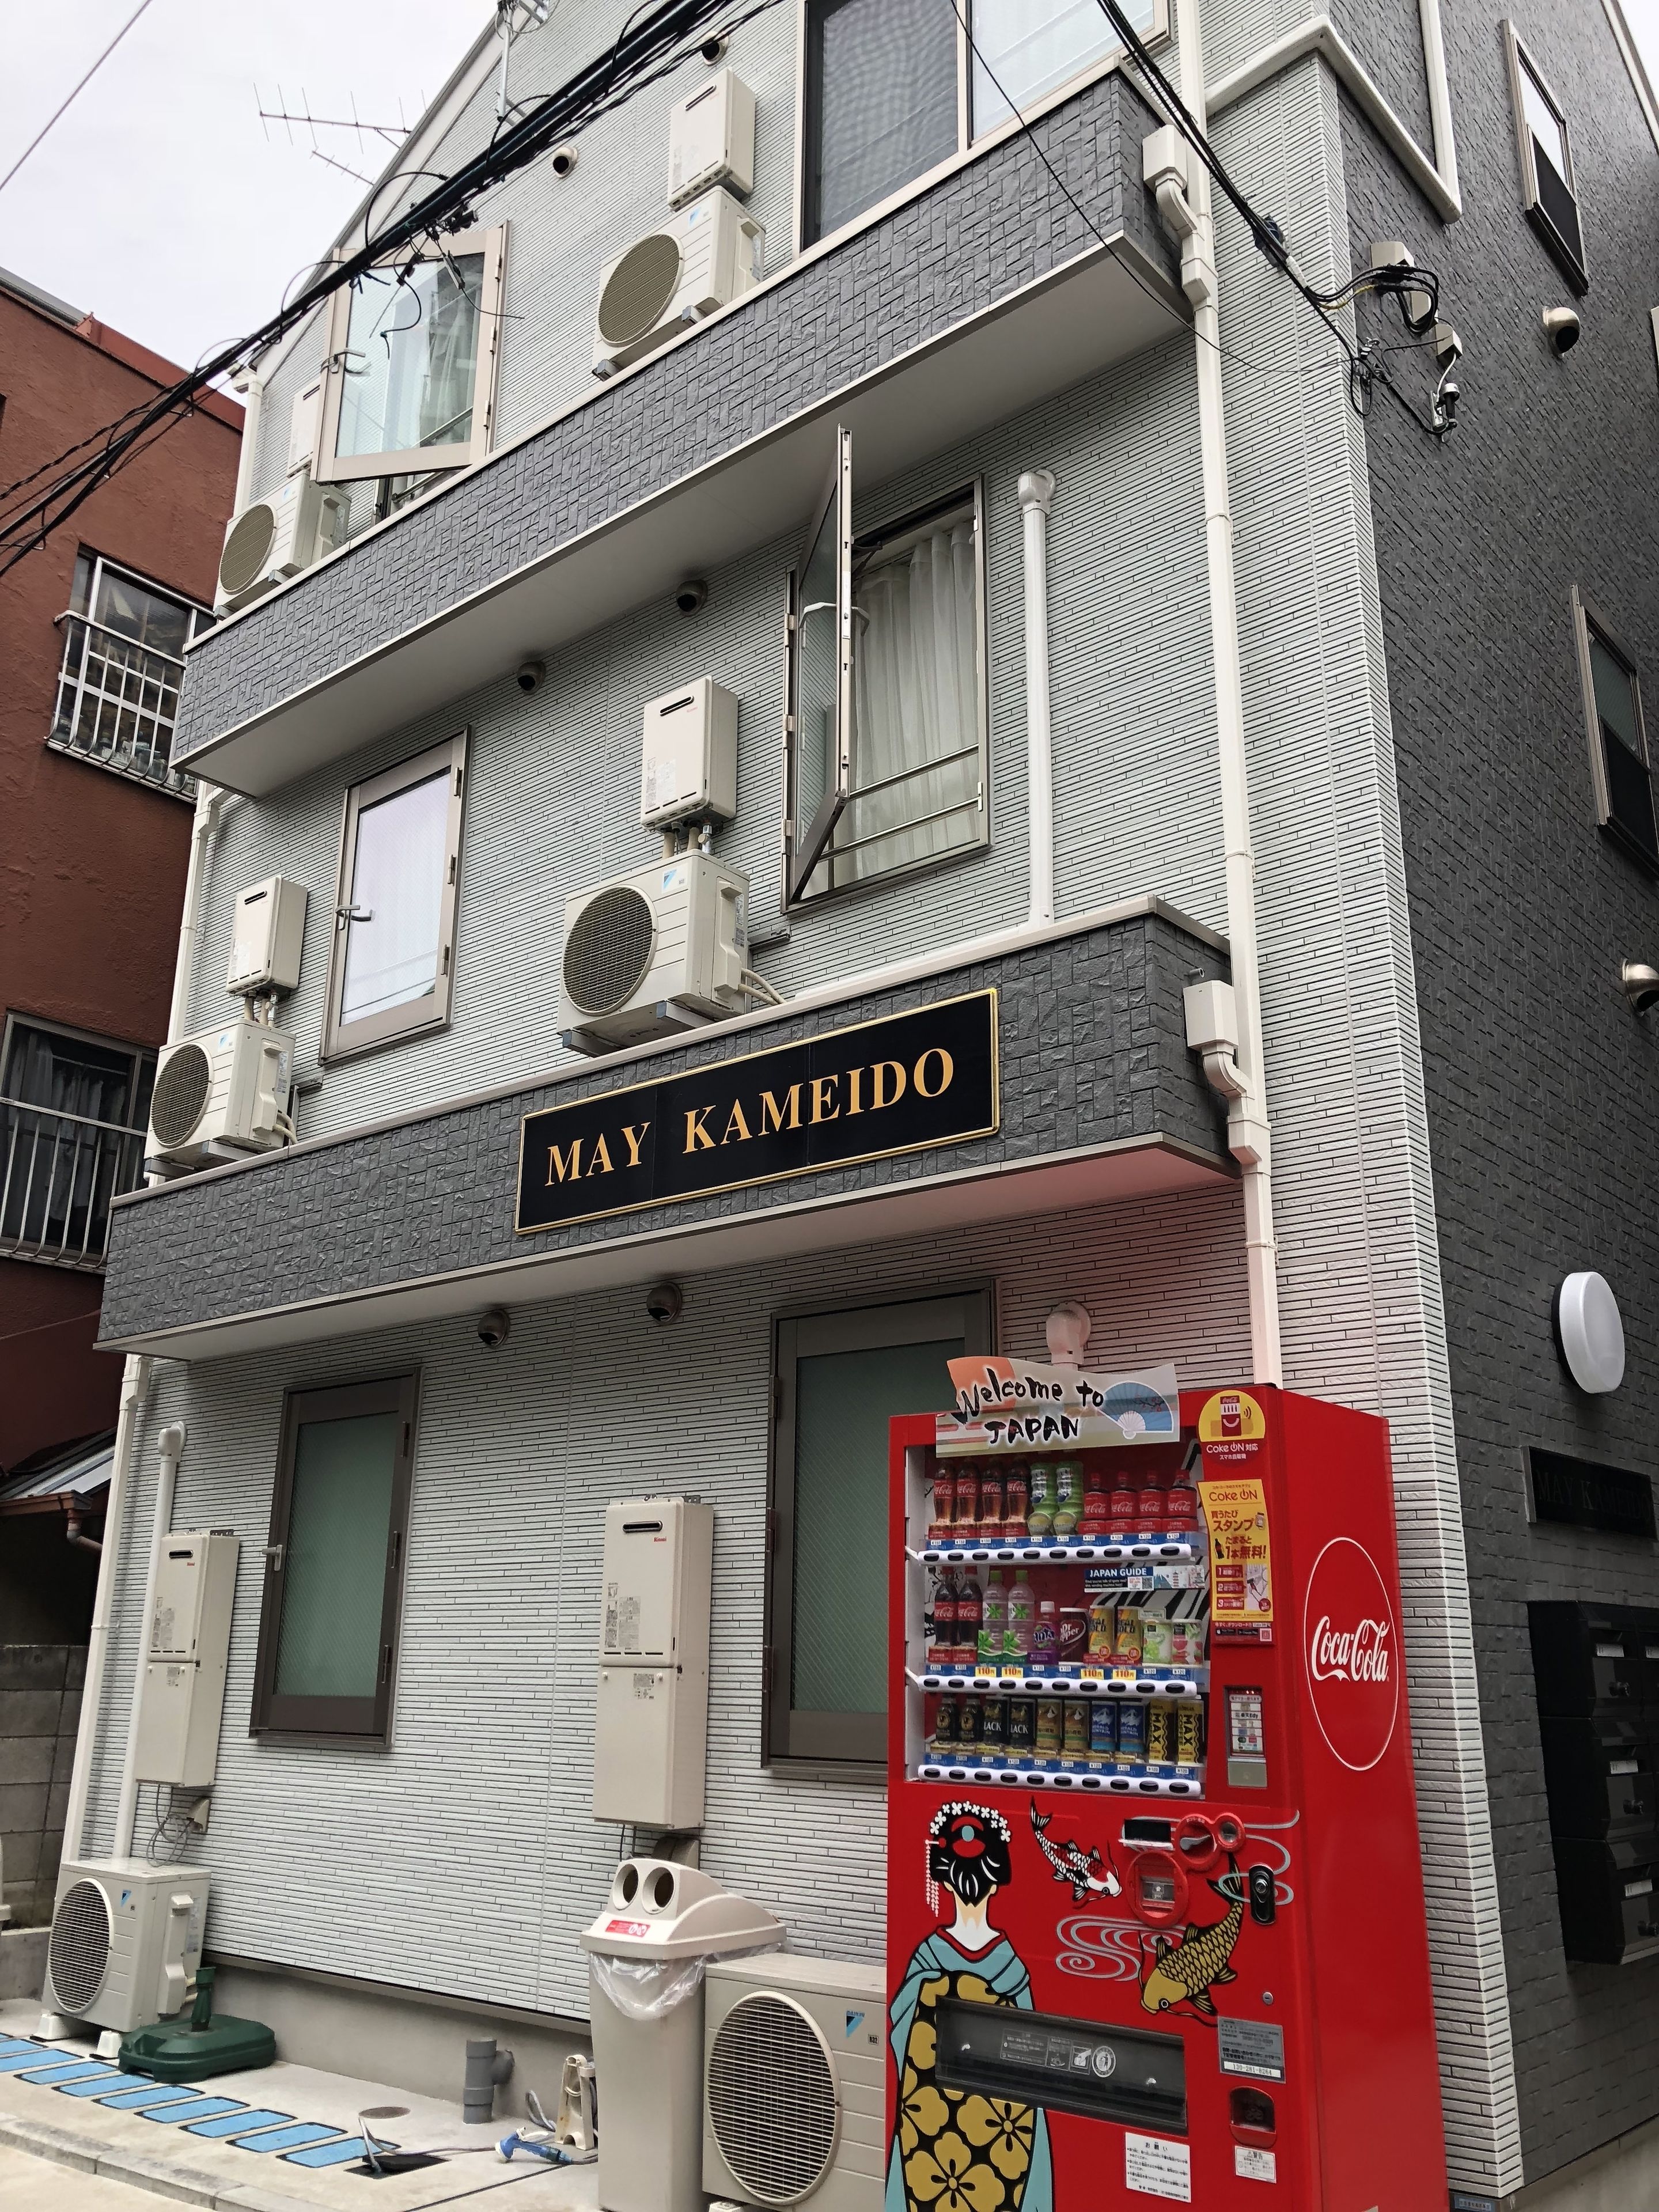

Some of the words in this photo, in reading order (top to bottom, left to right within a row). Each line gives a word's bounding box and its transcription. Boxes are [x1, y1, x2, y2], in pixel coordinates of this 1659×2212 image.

[544, 1122, 651, 1187] MAY
[682, 1047, 955, 1154] KAMEIDO
[951, 1368, 1063, 1425] Welcome
[1075, 1380, 1104, 1407] to
[984, 1414, 1079, 1444] JAPAN
[1206, 1444, 1229, 1453] Coke
[1230, 1441, 1244, 1452] ON
[1245, 1443, 1259, 1451] 対応
[1209, 1491, 1238, 1501] Coke
[1240, 1488, 1257, 1500] ON
[1211, 1509, 1238, 1519] 買うたび
[1213, 1518, 1255, 1532] スタンプ
[1225, 1535, 1252, 1544] たまると
[1089, 1568, 1118, 1577] JAPAN
[1119, 1567, 1147, 1576] GUIDE
[1312, 1616, 1391, 1682] Coca-Cola
[983, 1721, 1002, 1732] LACK
[1010, 1724, 1028, 1734] LACK
[1153, 1713, 1162, 1744] MAX
[1183, 1714, 1194, 1746] MAX
